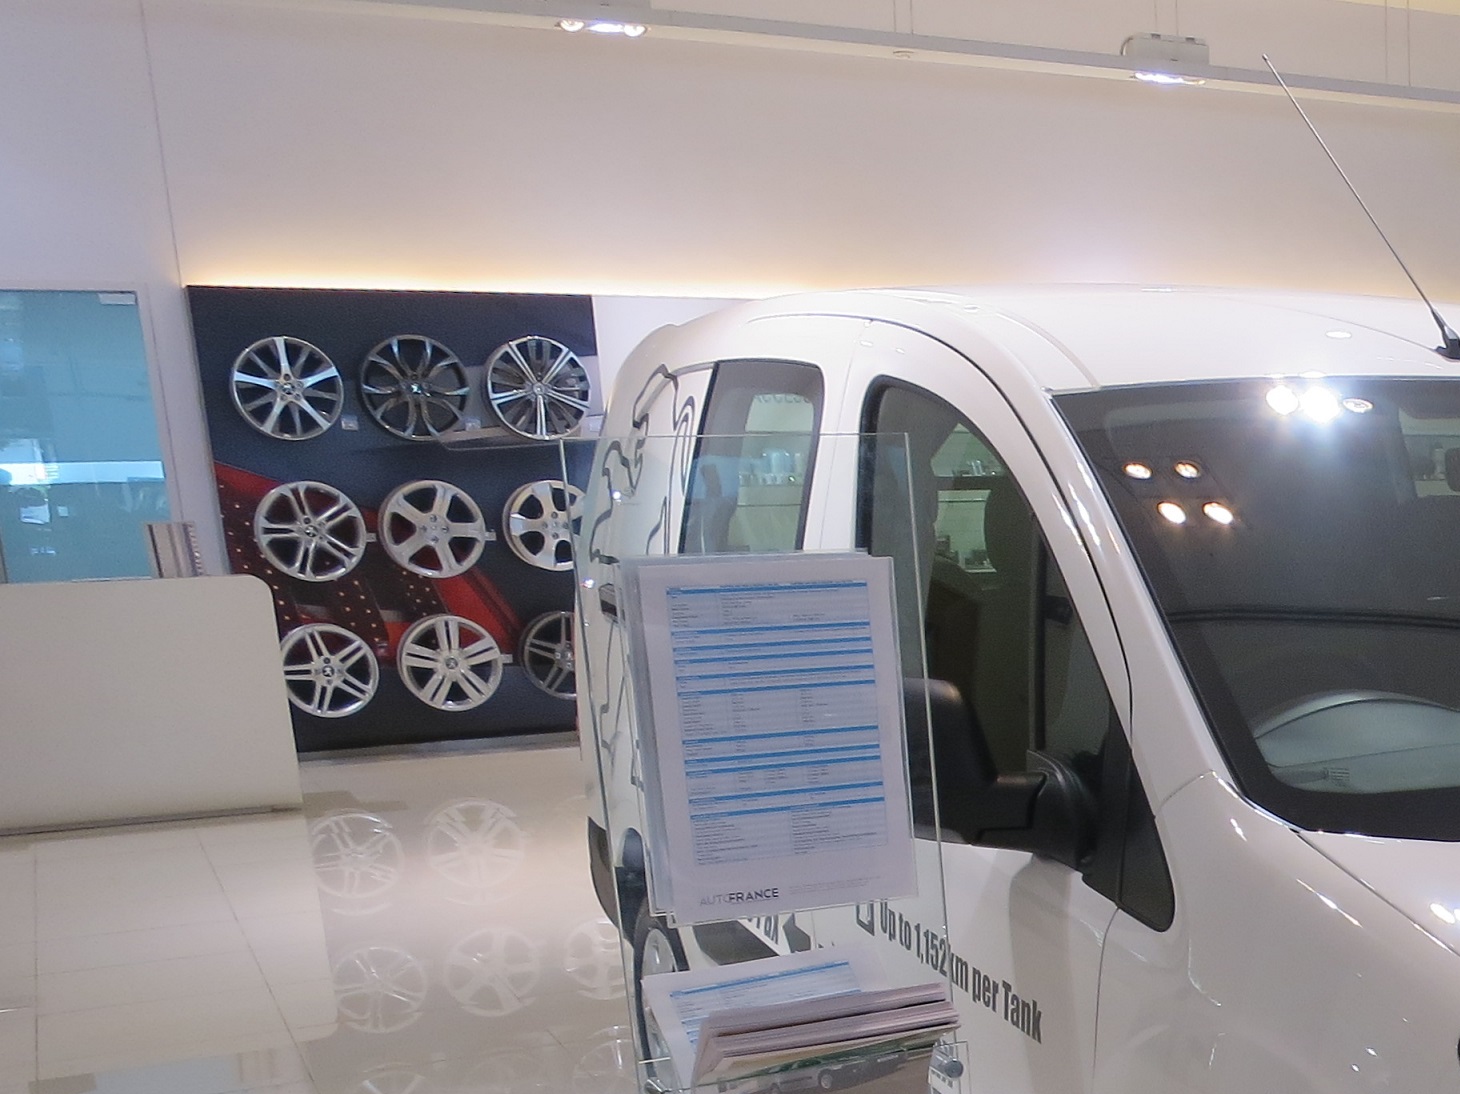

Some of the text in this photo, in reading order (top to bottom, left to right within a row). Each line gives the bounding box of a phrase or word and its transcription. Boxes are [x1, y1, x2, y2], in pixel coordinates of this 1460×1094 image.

[880, 899, 896, 942] Up
[899, 912, 912, 951] to
[914, 922, 948, 978] 1,152
[972, 967, 999, 1013] per
[1002, 980, 1042, 1044] Tank
